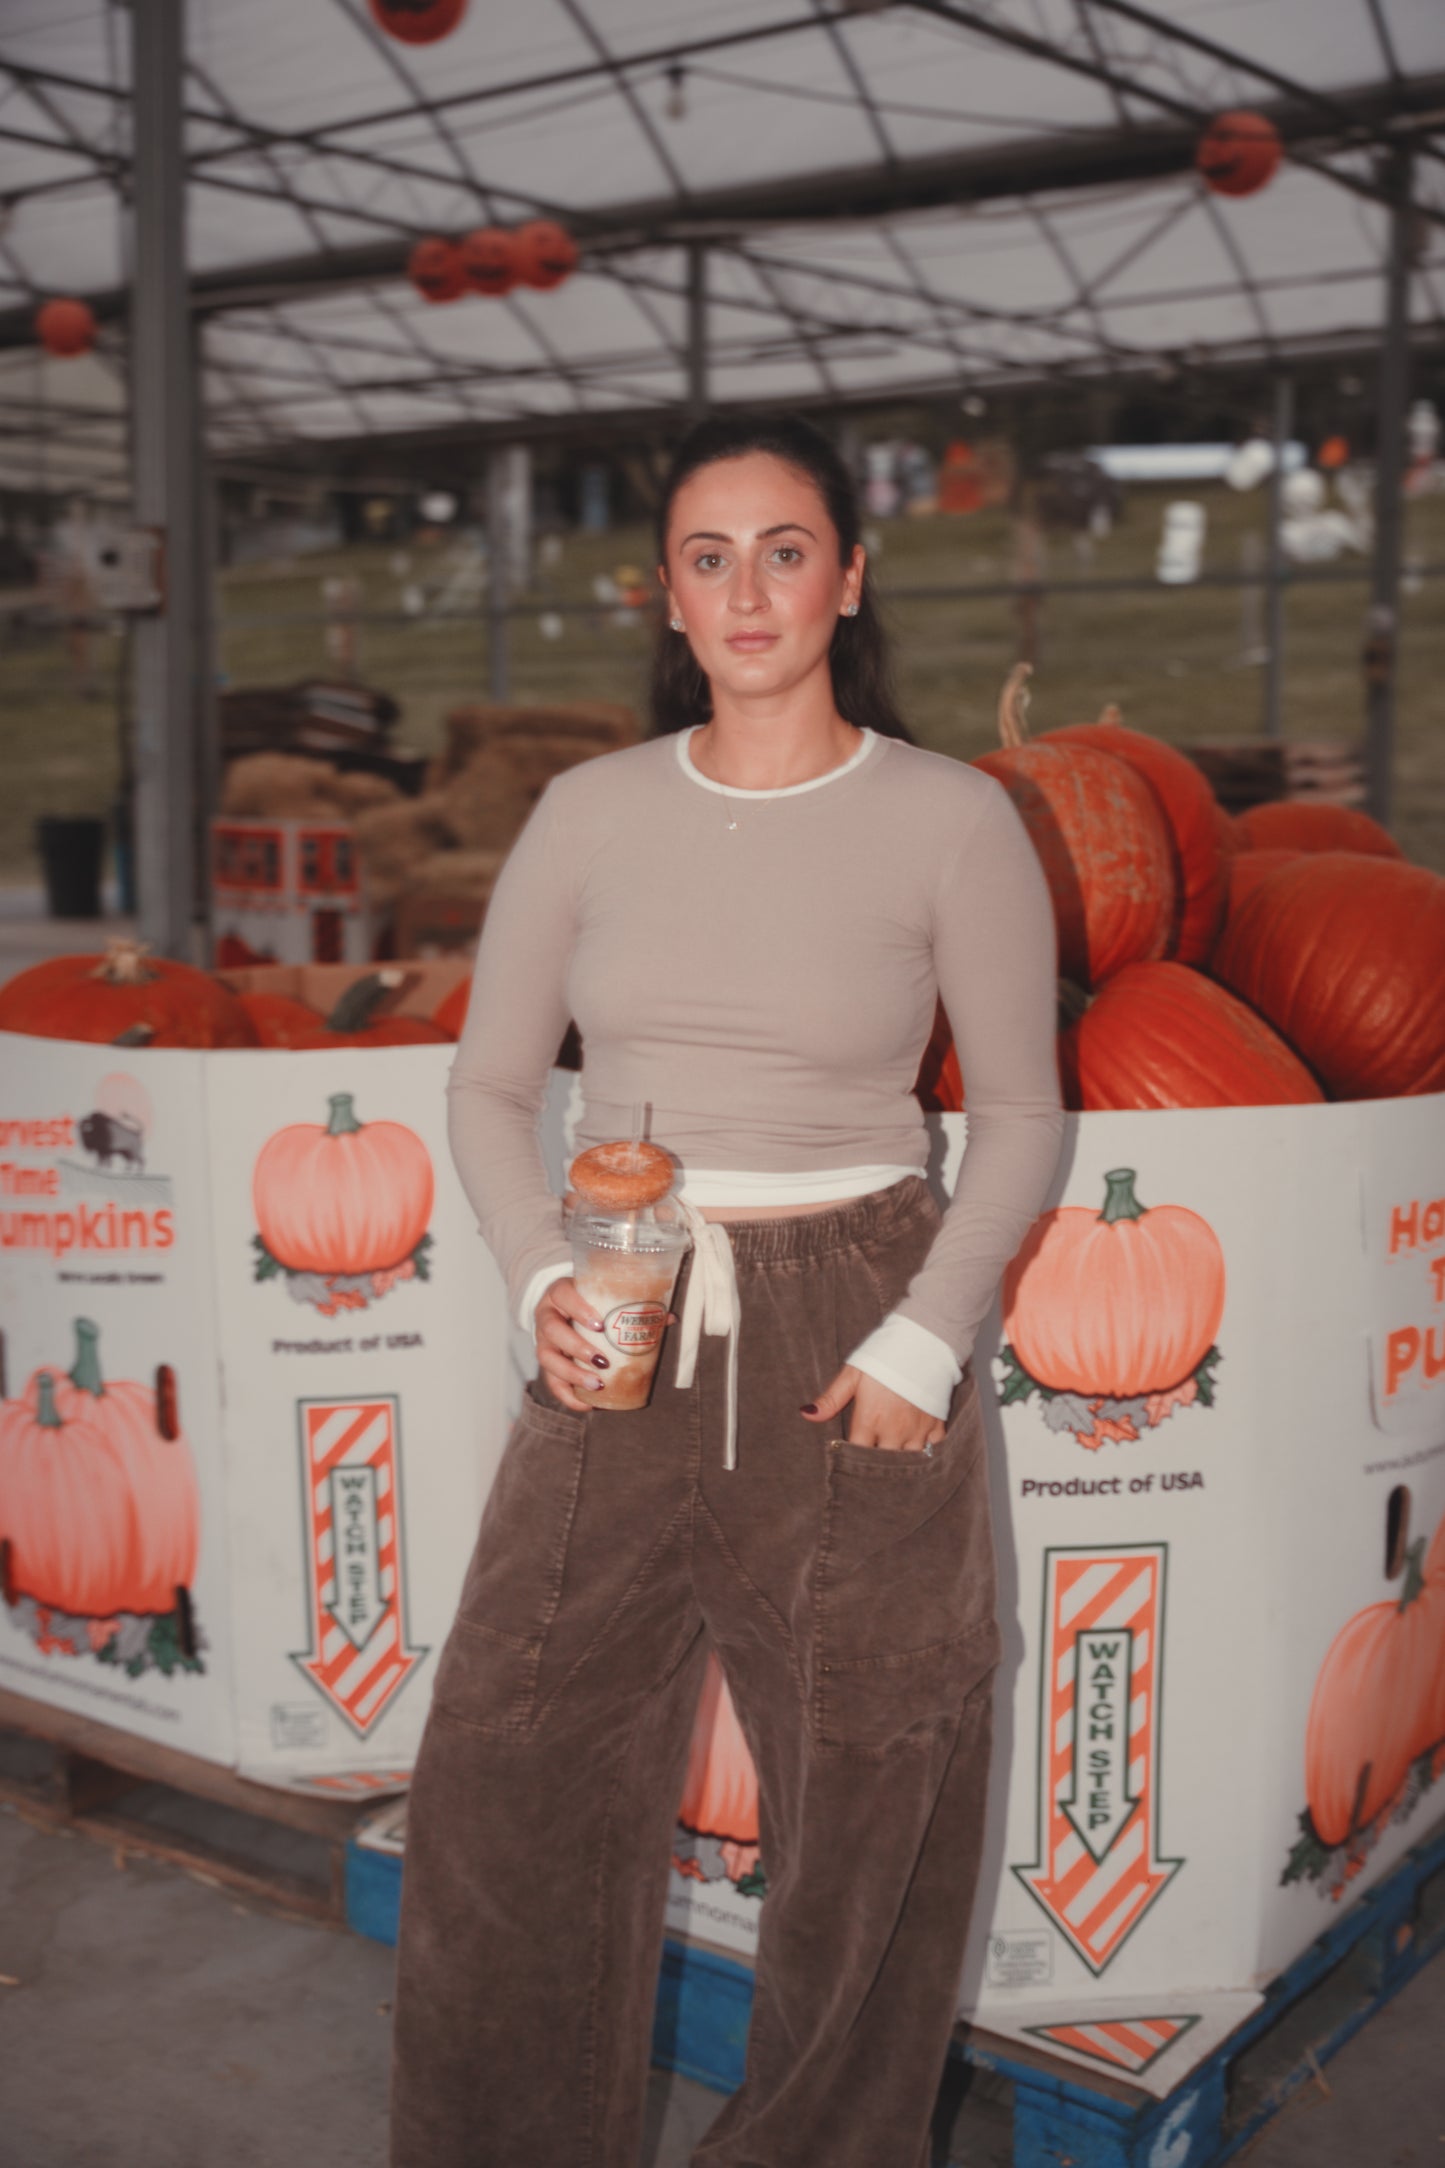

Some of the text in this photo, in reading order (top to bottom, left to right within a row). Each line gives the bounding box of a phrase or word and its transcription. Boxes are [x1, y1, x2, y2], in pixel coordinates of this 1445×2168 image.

[272, 1332, 424, 1356] Product of USA
[1021, 1472, 1205, 1497] Product of USA
[341, 1477, 367, 1625] WATCH STEP
[1087, 1641, 1120, 1831] WATCH STEP
